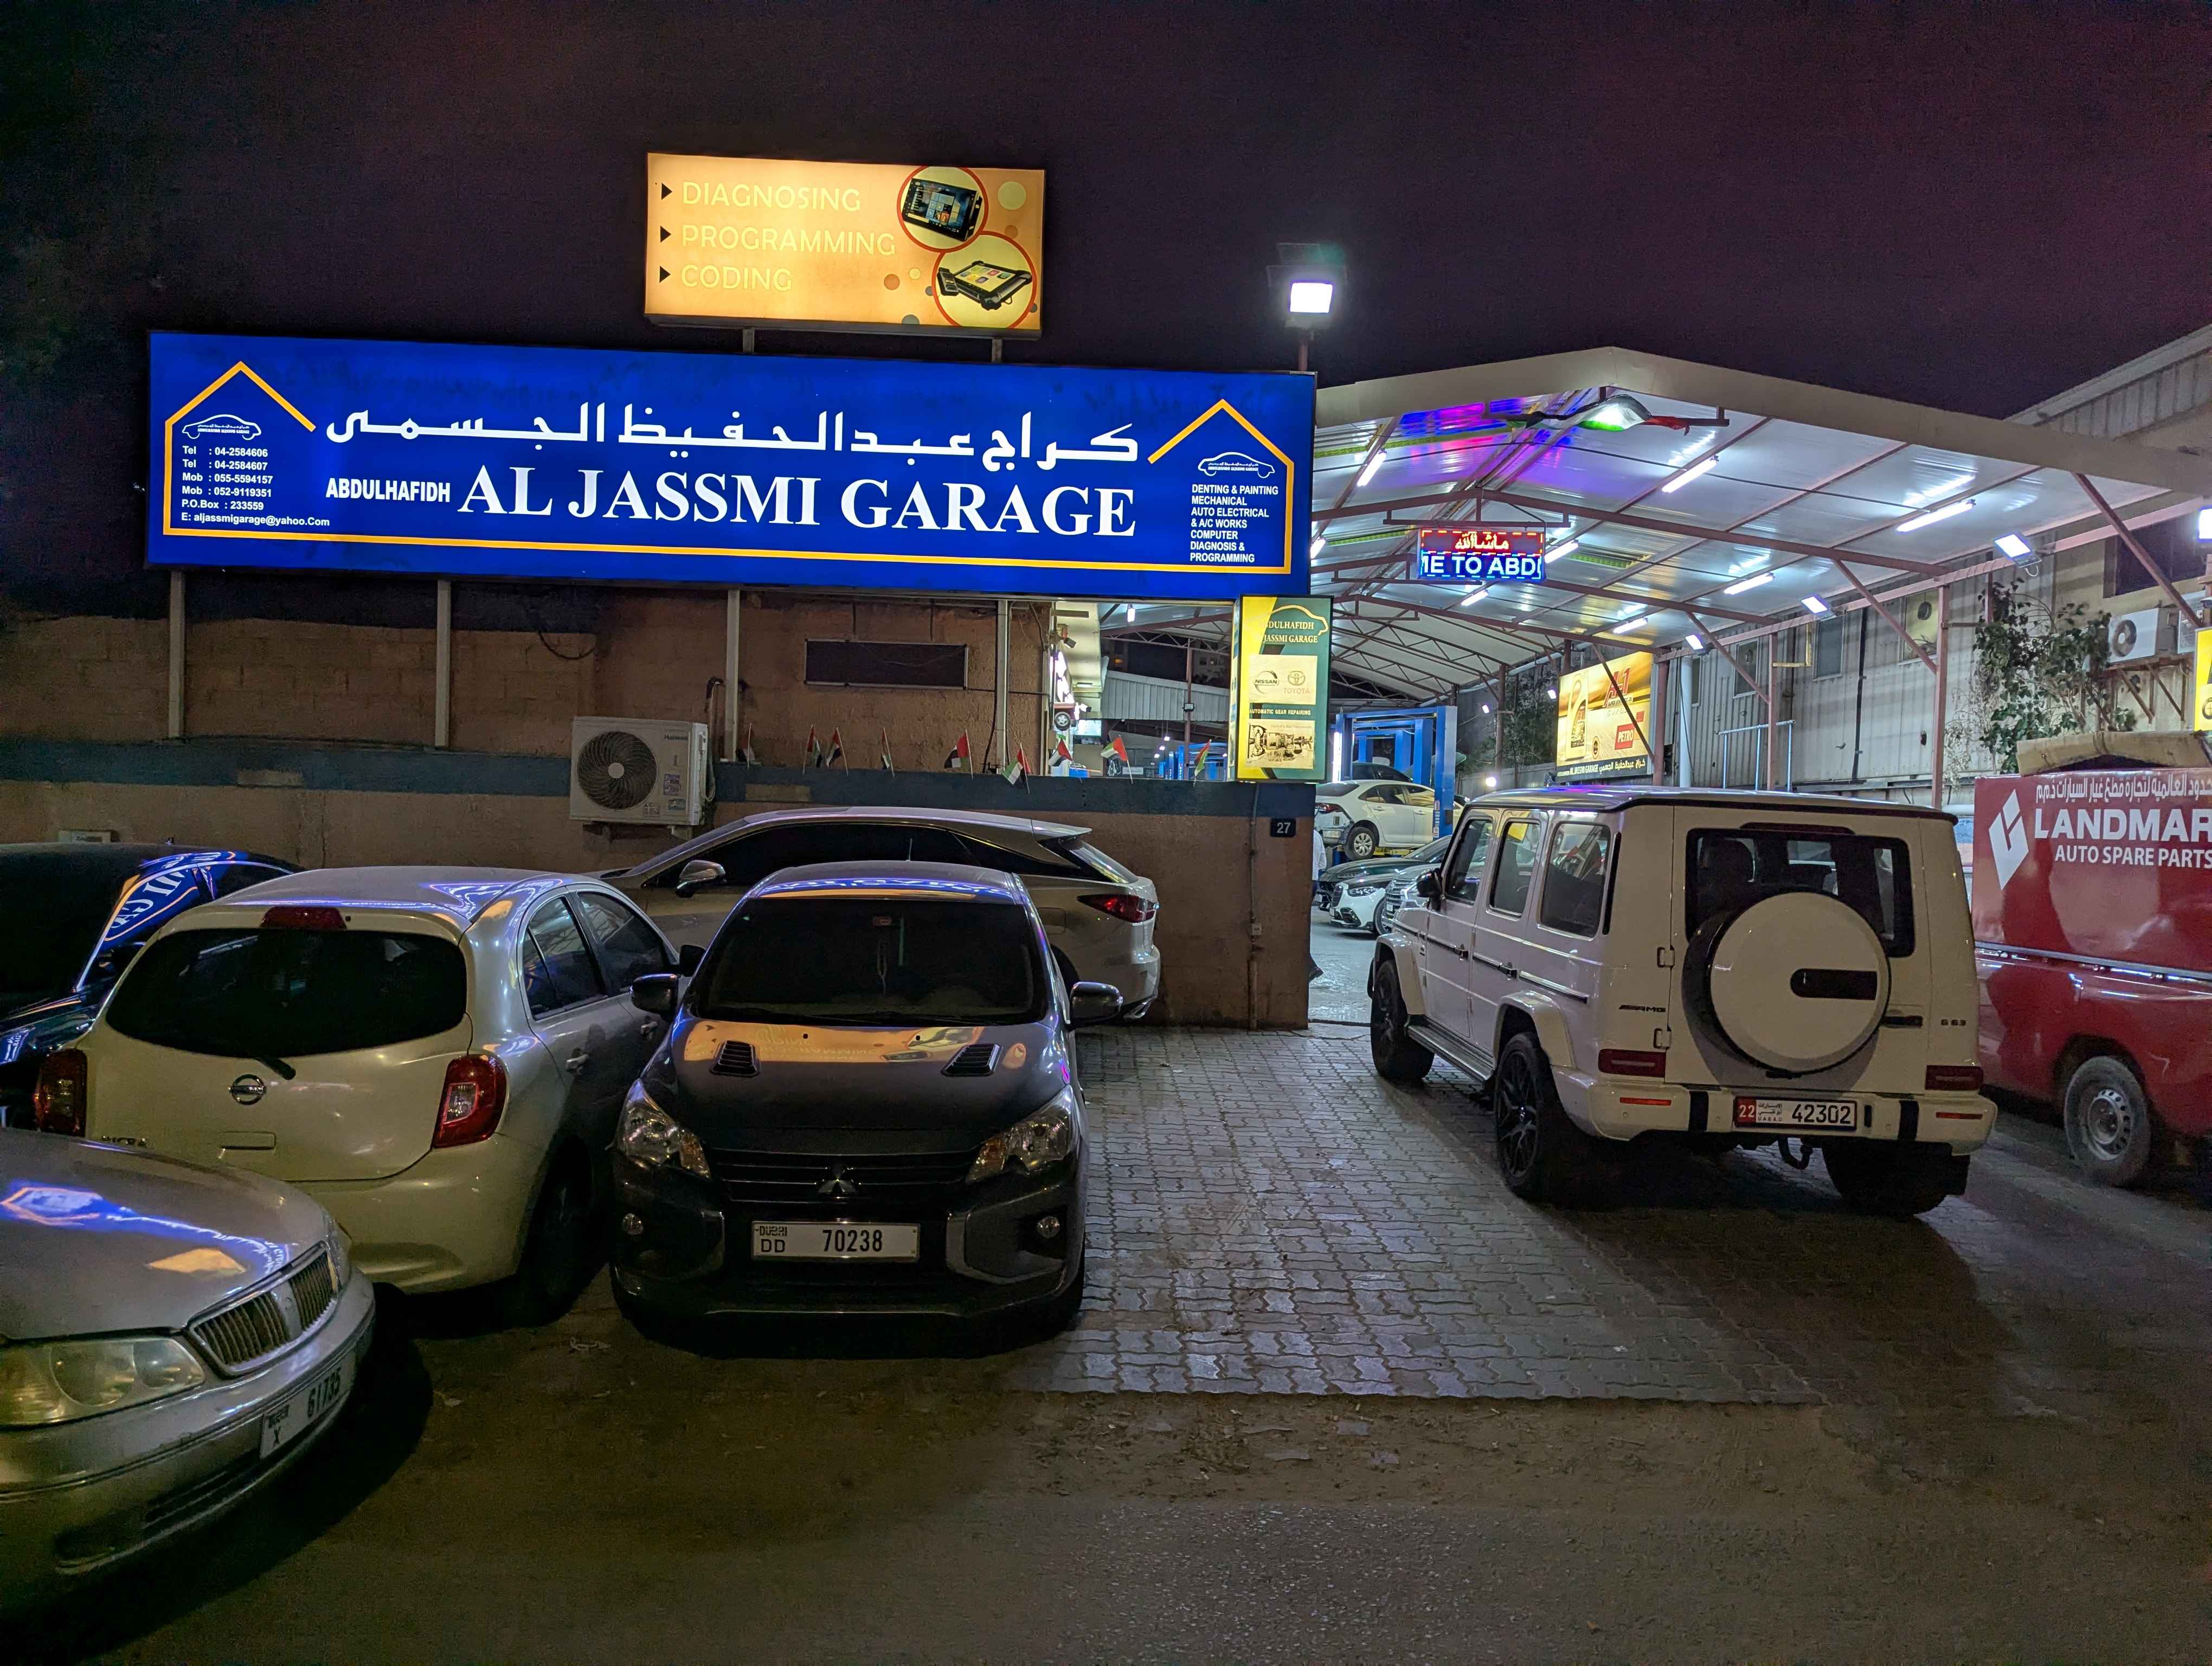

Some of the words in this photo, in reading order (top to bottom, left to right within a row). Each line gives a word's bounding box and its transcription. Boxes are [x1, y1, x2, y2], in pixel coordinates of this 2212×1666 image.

[683, 181, 860, 212] DIAGNOSING
[681, 224, 896, 256] PROGRAMMING
[681, 264, 793, 291] CODING
[982, 411, 1138, 472] كراج
[182, 445, 196, 454] Tel
[214, 446, 268, 457] 04-2584606
[182, 459, 196, 468] Tel
[214, 460, 268, 471] 04-2584607
[182, 472, 203, 482] Mob
[214, 473, 273, 484] 055-5594157
[182, 485, 203, 495] Mob
[214, 486, 271, 497] 052-9119351
[1192, 484, 1229, 494] DENTING
[1231, 485, 1238, 494] &
[1239, 485, 1278, 495] PAINTING
[182, 498, 220, 509] P.O.Box
[230, 501, 264, 510] 233559
[325, 478, 451, 503] ABDULHAFIDH
[457, 465, 553, 516] AL
[568, 470, 821, 525] JASSMI
[841, 479, 1136, 536] GARAGE
[1192, 496, 1248, 505] MECHANICAL
[181, 512, 191, 521] E:
[1191, 507, 1215, 516] AUTO
[1217, 508, 1269, 517] ELECTRICAL
[1191, 518, 1197, 527] &
[1198, 518, 1213, 528] A/C
[1215, 519, 1248, 529] WORKS
[1190, 530, 1238, 540] COMPUTER
[1190, 541, 1237, 551] DIAGNOSIS
[1238, 542, 1245, 551] &
[1190, 552, 1255, 563] PROGRAMMING
[1451, 556, 1482, 574] TO
[1266, 620, 1314, 630] DULHAFIDH
[1263, 634, 1288, 643] JASSMI
[1289, 635, 1318, 643] GARAGE
[1617, 729, 1634, 743] PETRO
[1276, 822, 1291, 834] 27
[2055, 845, 2099, 863] AUTO
[2102, 846, 2155, 866] SPARE
[2158, 848, 2212, 869] PARTS
[1739, 1105, 1755, 1118] 22
[1792, 1104, 1851, 1124] 42302
[761, 1239, 786, 1253] DD
[822, 1229, 883, 1252] 70238
